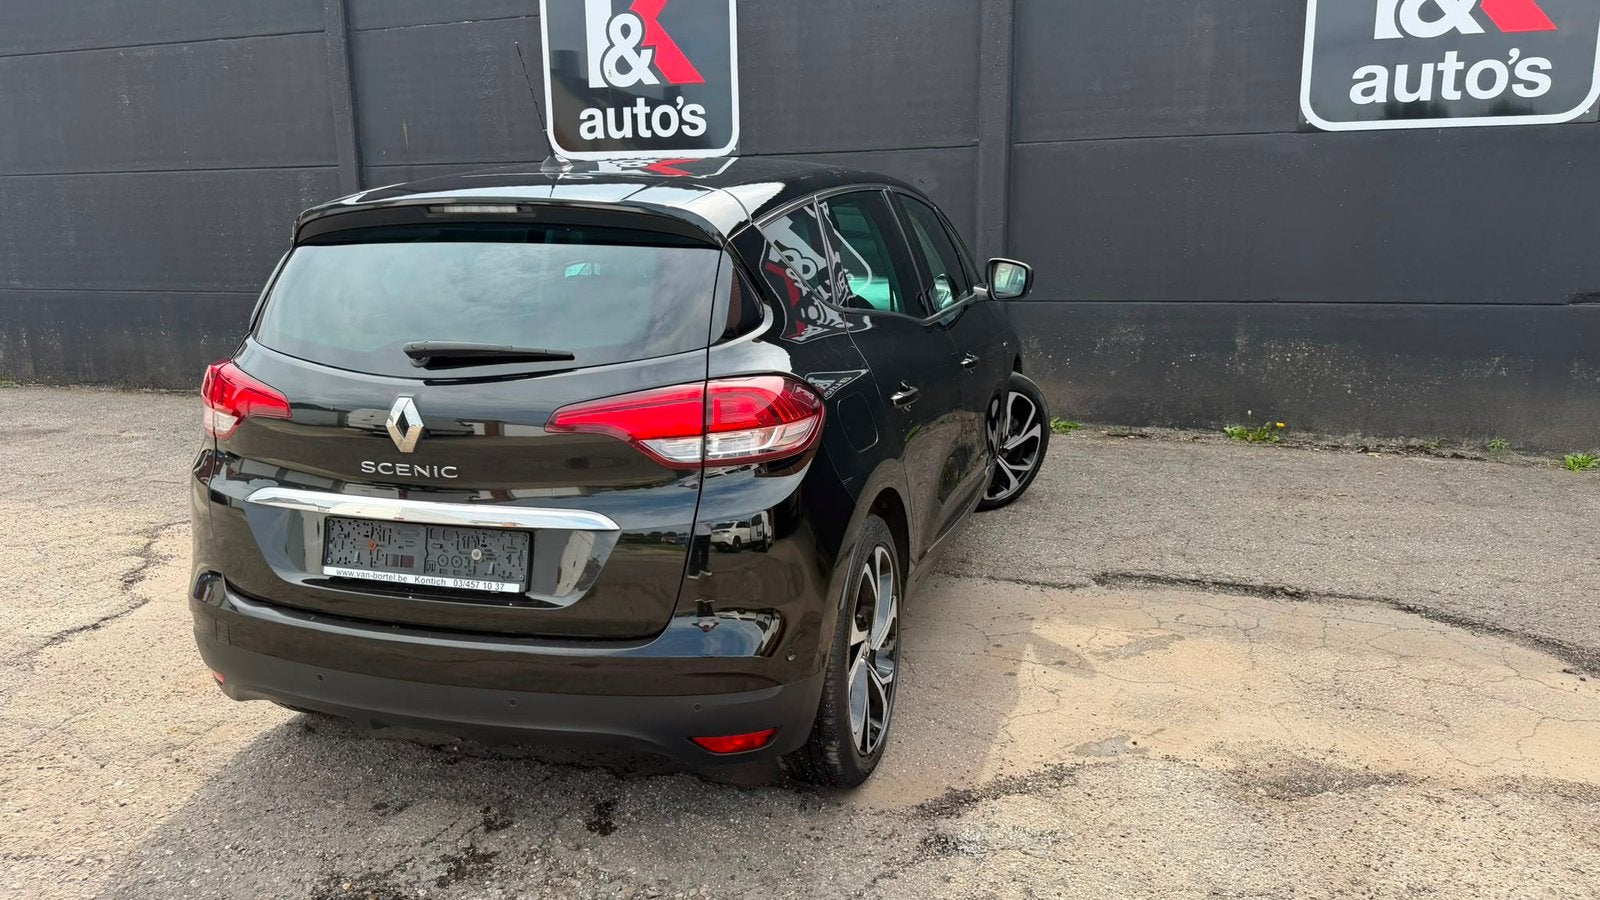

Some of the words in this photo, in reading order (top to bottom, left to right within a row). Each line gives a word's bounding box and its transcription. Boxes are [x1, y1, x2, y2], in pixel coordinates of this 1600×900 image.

[1349, 47, 1553, 105] auto's
[579, 96, 707, 140] auto's
[360, 460, 458, 479] SCENIC
[335, 567, 408, 583] www.van-bortel.be
[414, 576, 446, 587] Kontich
[453, 579, 480, 589] 03/457
[483, 581, 493, 590] 10
[495, 581, 505, 591] 37
